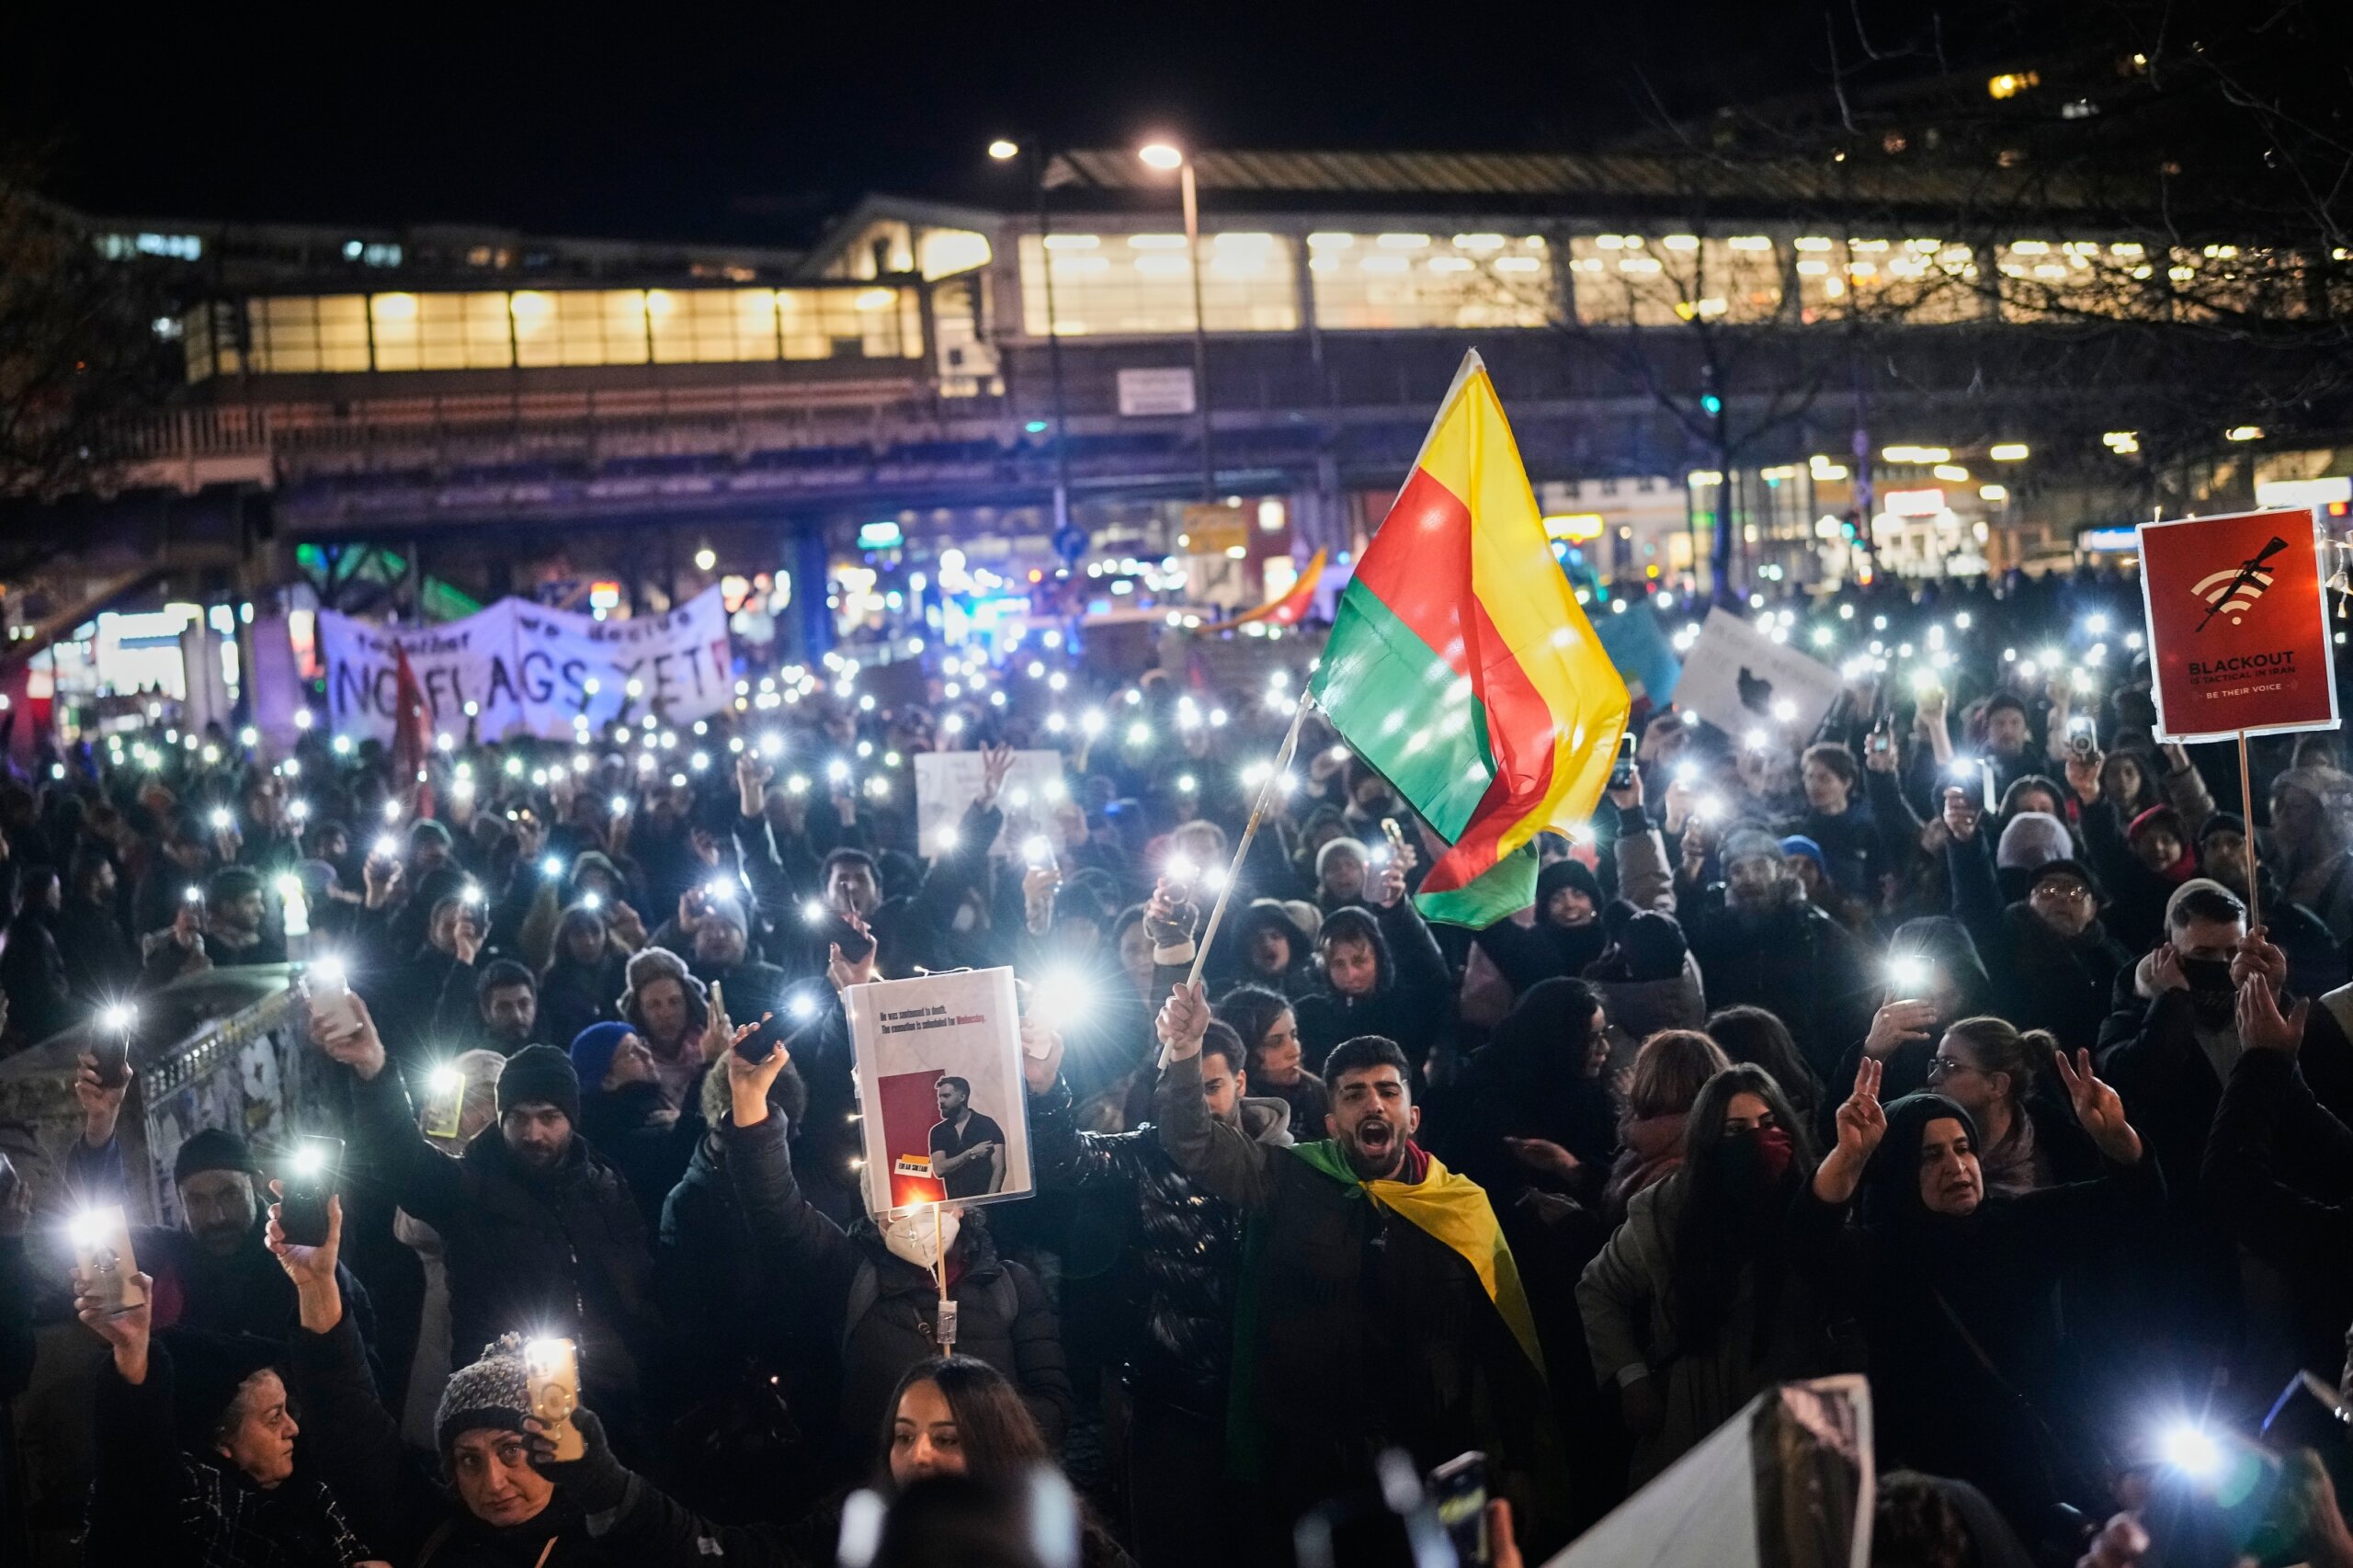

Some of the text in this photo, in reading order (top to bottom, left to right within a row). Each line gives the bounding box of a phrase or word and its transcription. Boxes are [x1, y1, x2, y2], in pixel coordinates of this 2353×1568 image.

[2188, 651, 2294, 675] BLACKOUT
[2202, 672, 2251, 683] TACTICAL
[2255, 668, 2267, 677] IN
[2270, 665, 2296, 676] IRAN
[2222, 687, 2250, 698] THEIR
[2252, 683, 2282, 693] VOICE
[888, 1012, 899, 1020] was
[899, 1007, 926, 1019] sentenced
[925, 1007, 931, 1017] to
[881, 1025, 891, 1034] The
[891, 1022, 916, 1033] execution
[915, 1021, 922, 1030] is
[922, 1017, 948, 1029] scheduled
[948, 1017, 956, 1026] for
